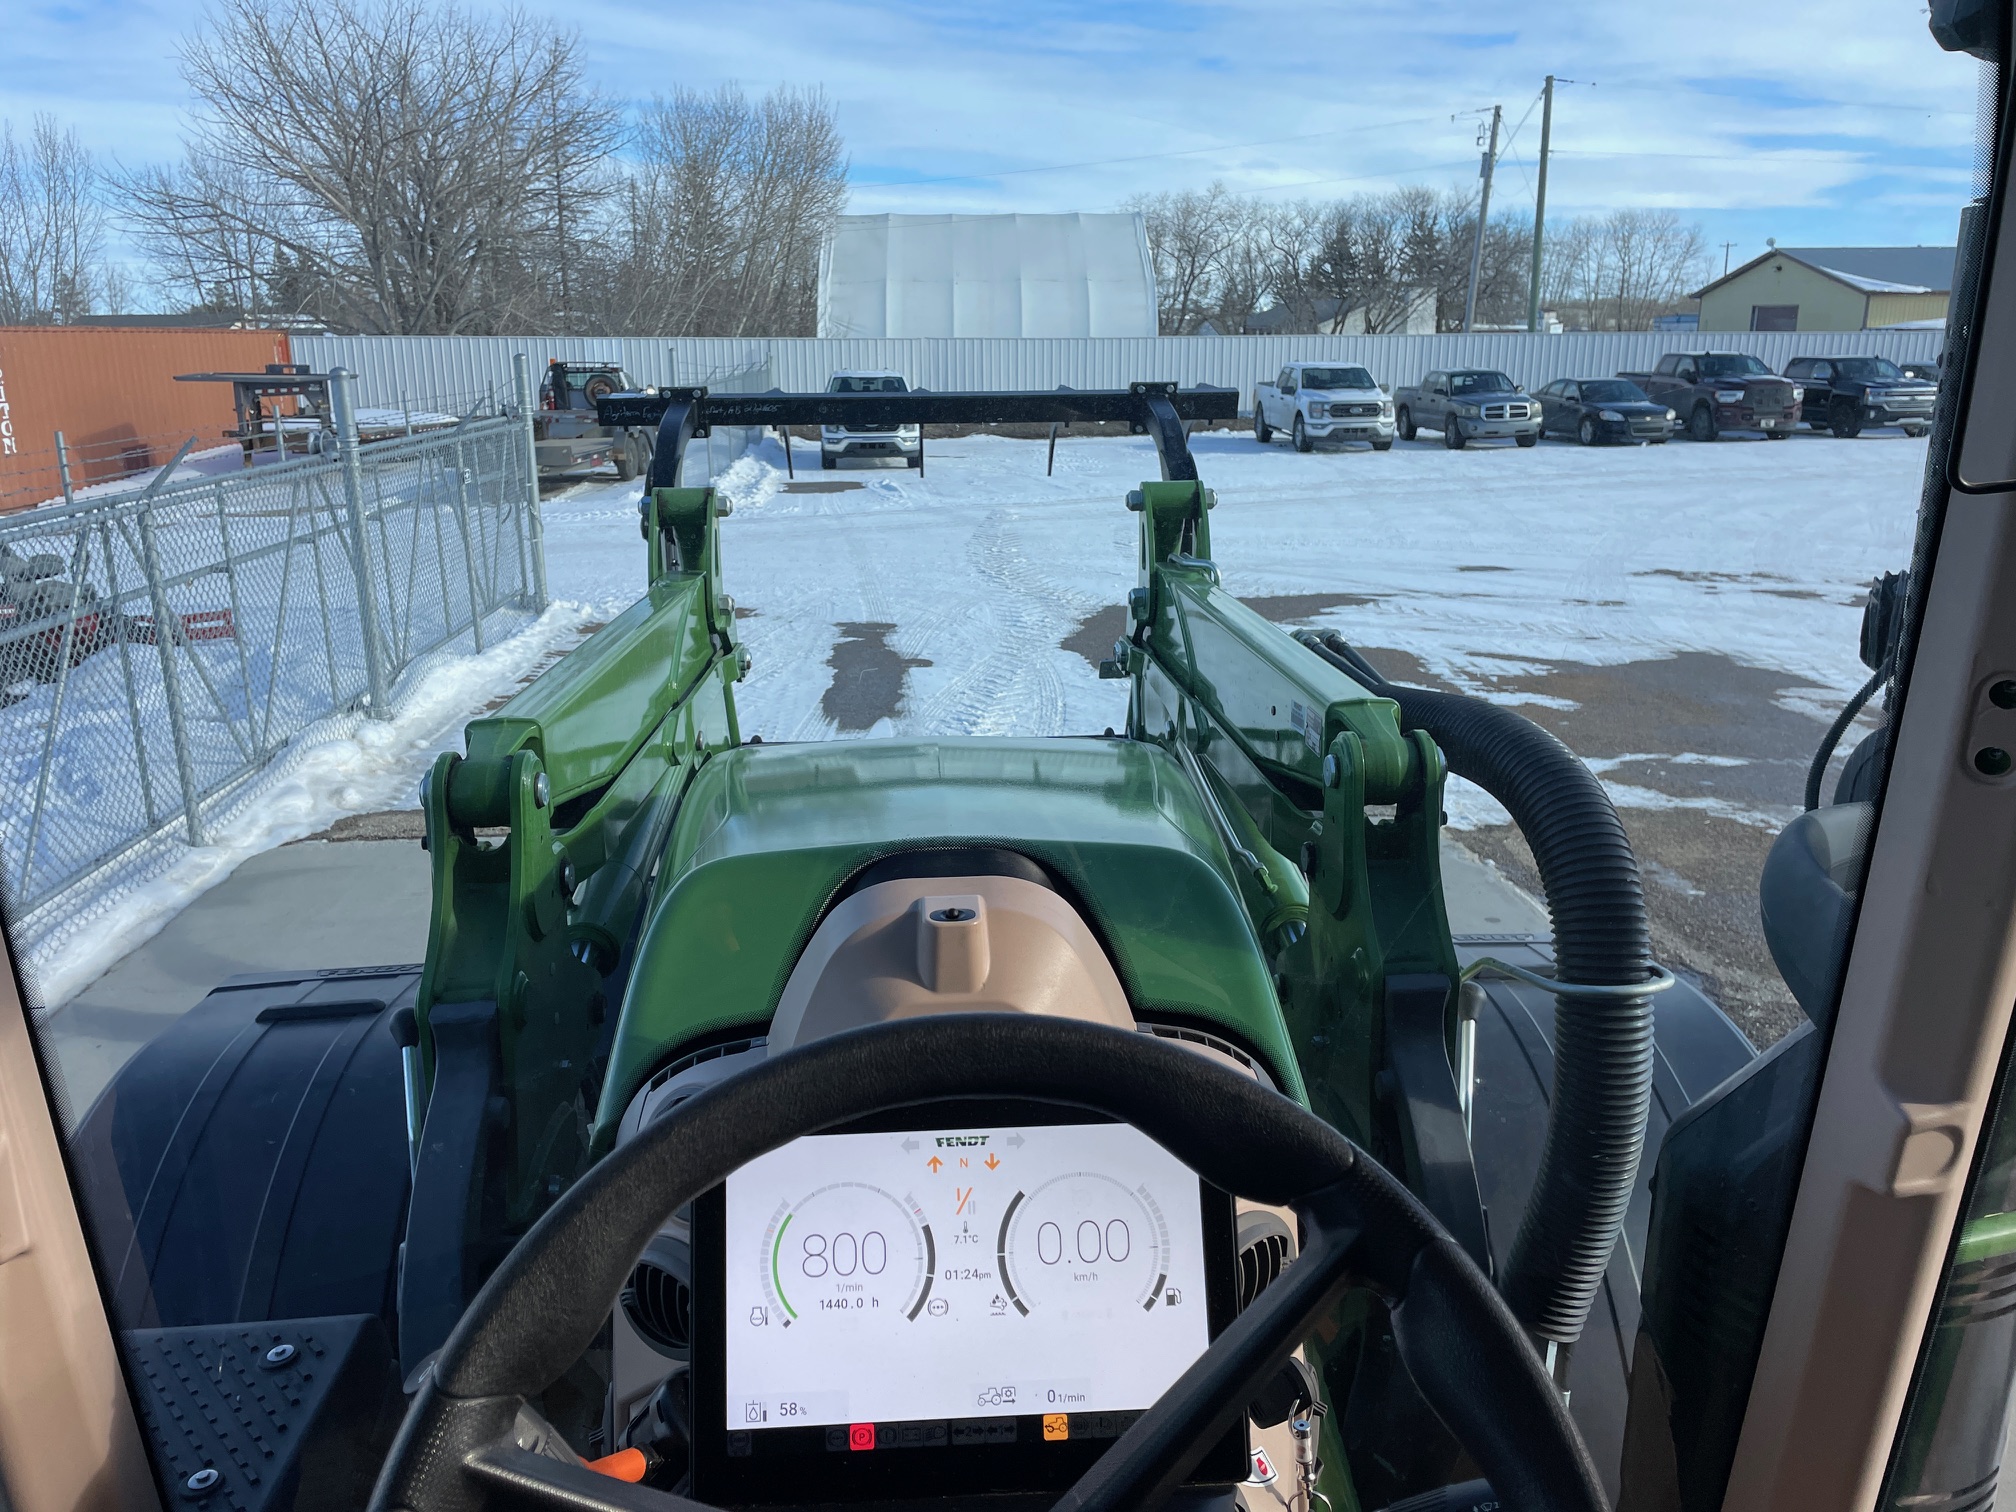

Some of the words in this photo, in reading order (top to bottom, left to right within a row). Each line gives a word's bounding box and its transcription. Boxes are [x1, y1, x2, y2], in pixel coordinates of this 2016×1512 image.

[935, 1135, 990, 1148] FENDT
[960, 1158, 968, 1168] N
[954, 1235, 979, 1244] 7.1°C
[1037, 1218, 1130, 1265] 0.00
[802, 1231, 886, 1278] 800
[1073, 1272, 1098, 1282] km/h
[836, 1283, 863, 1293] 1/min
[819, 1297, 863, 1311] 1440.0
[872, 1297, 879, 1308] h
